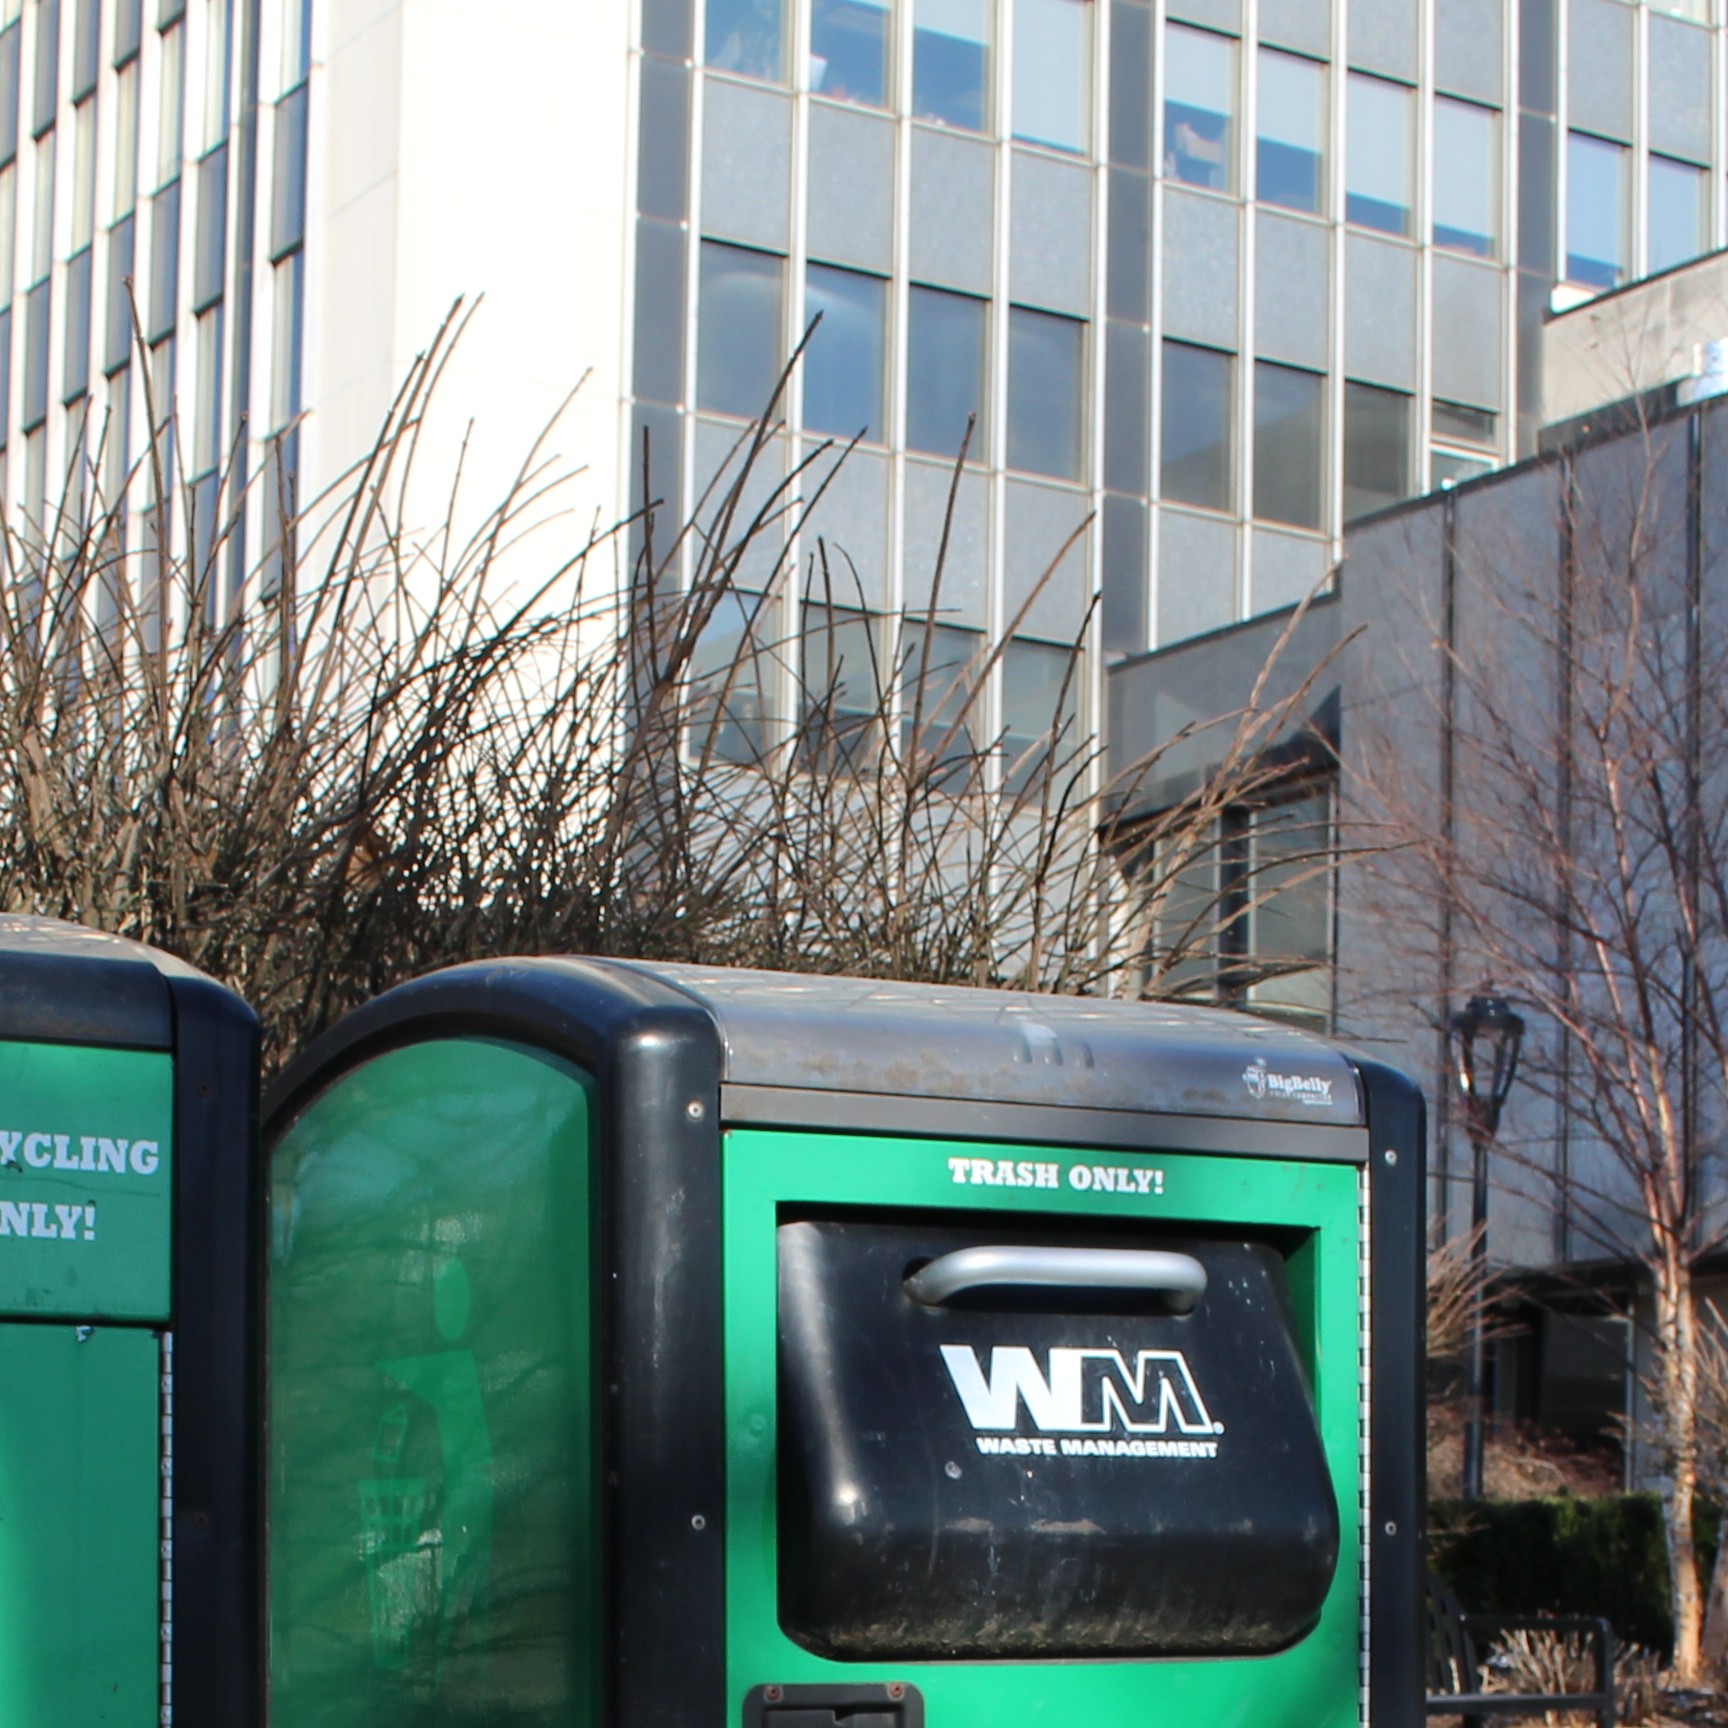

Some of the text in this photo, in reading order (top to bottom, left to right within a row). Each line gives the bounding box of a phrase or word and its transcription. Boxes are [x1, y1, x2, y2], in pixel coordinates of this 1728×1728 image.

[1267, 1073, 1332, 1095] BigBelly
[948, 1157, 1165, 1195] TRASH ONLY!
[939, 1344, 1215, 1434] WM
[975, 1437, 1218, 1458] WASTE MANAGEMENT
